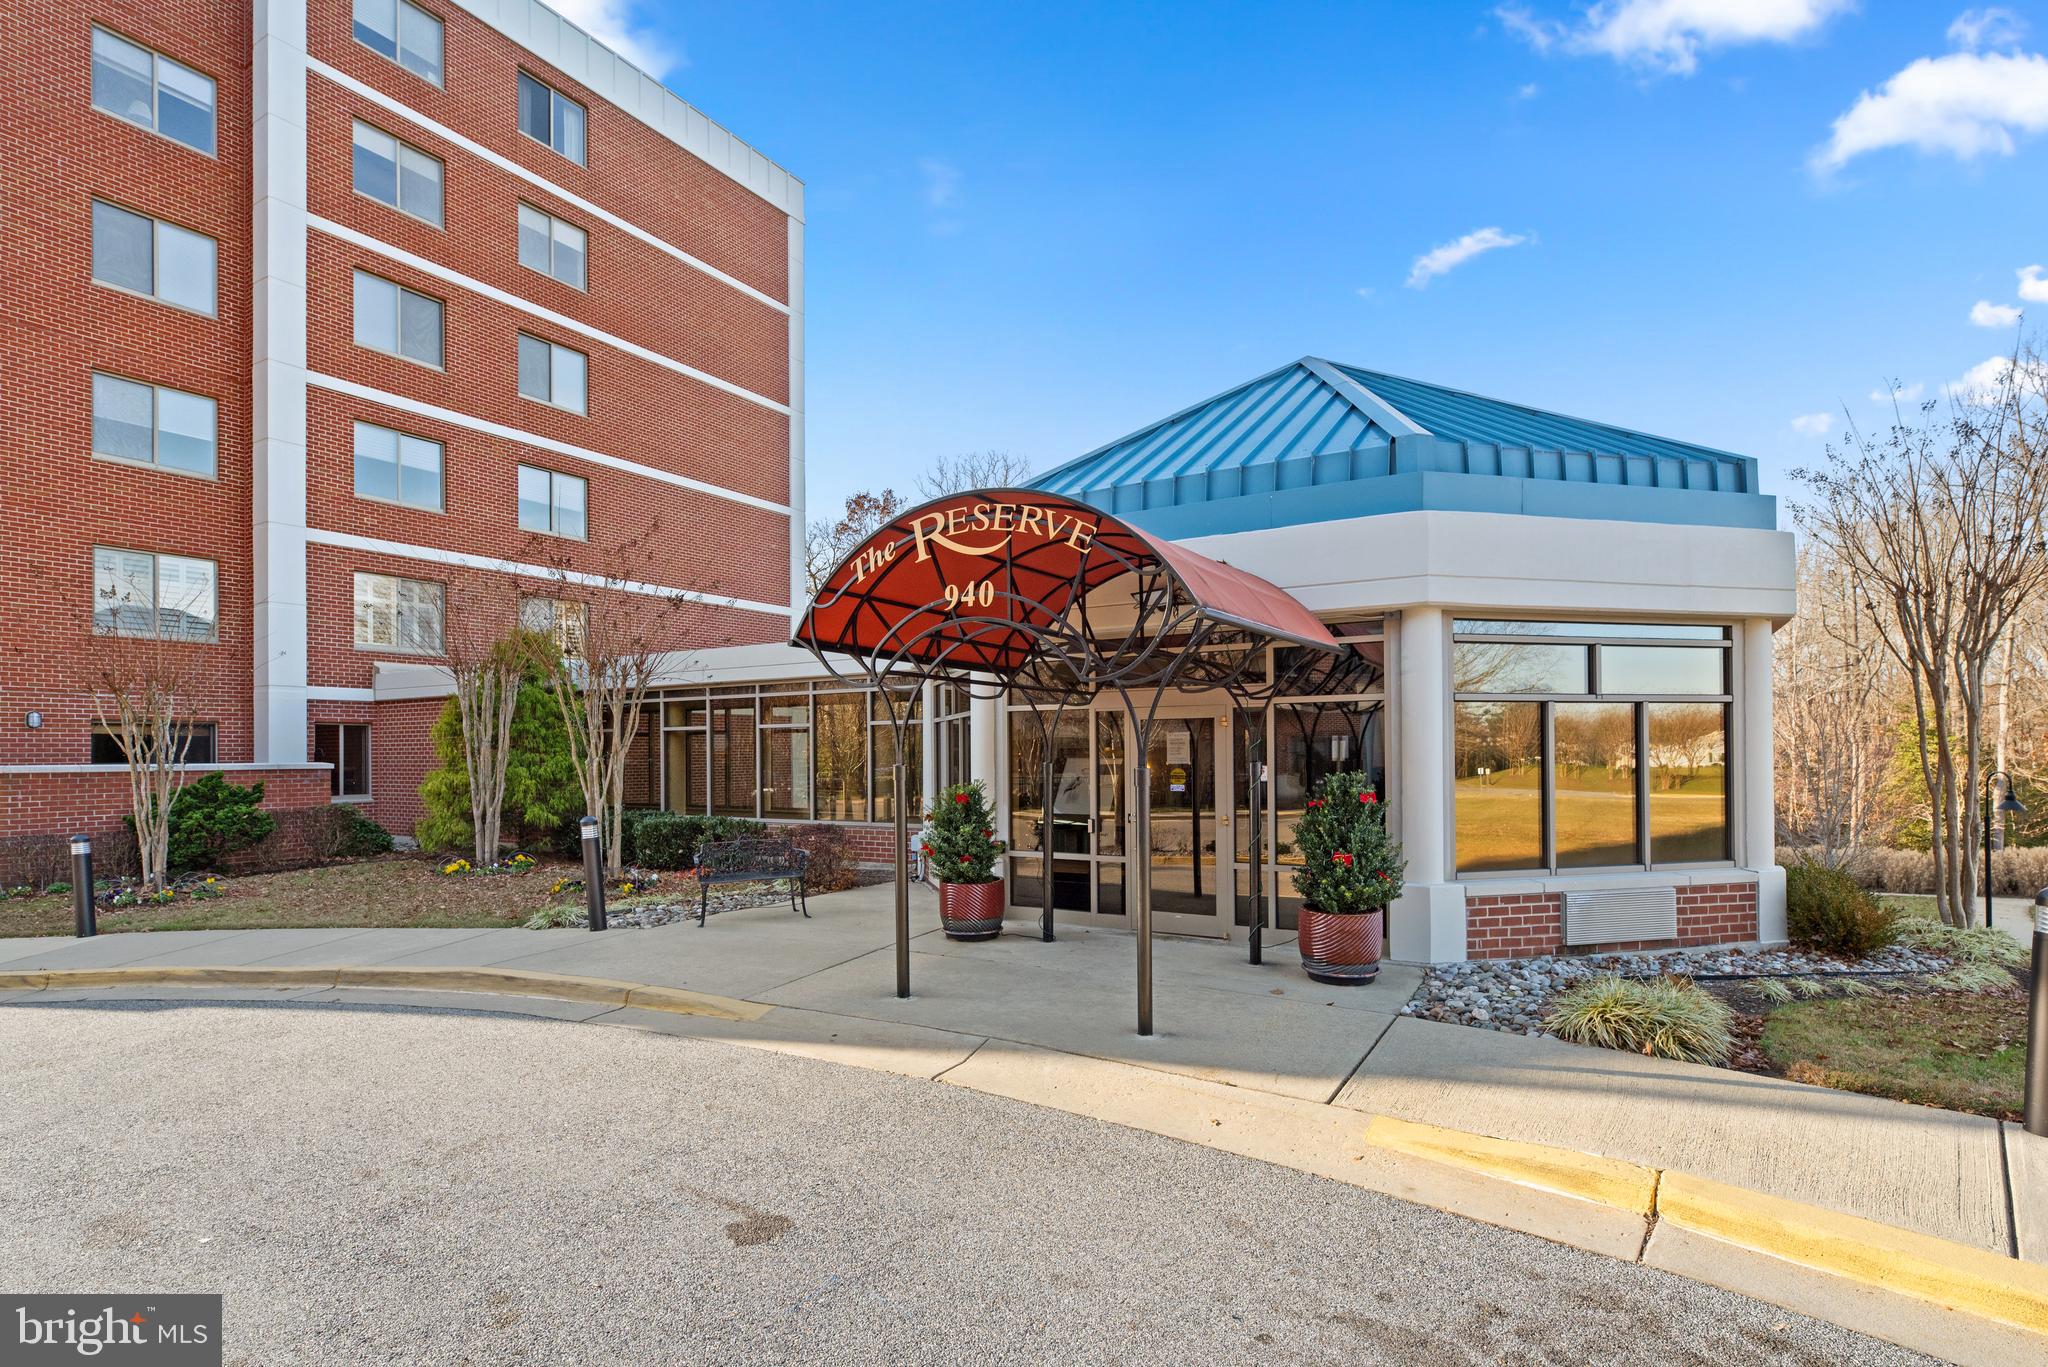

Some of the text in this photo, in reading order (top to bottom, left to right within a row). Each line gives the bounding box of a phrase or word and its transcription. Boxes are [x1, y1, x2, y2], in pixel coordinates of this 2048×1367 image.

[850, 503, 1098, 585] The RESERVE
[944, 580, 995, 611] 940
